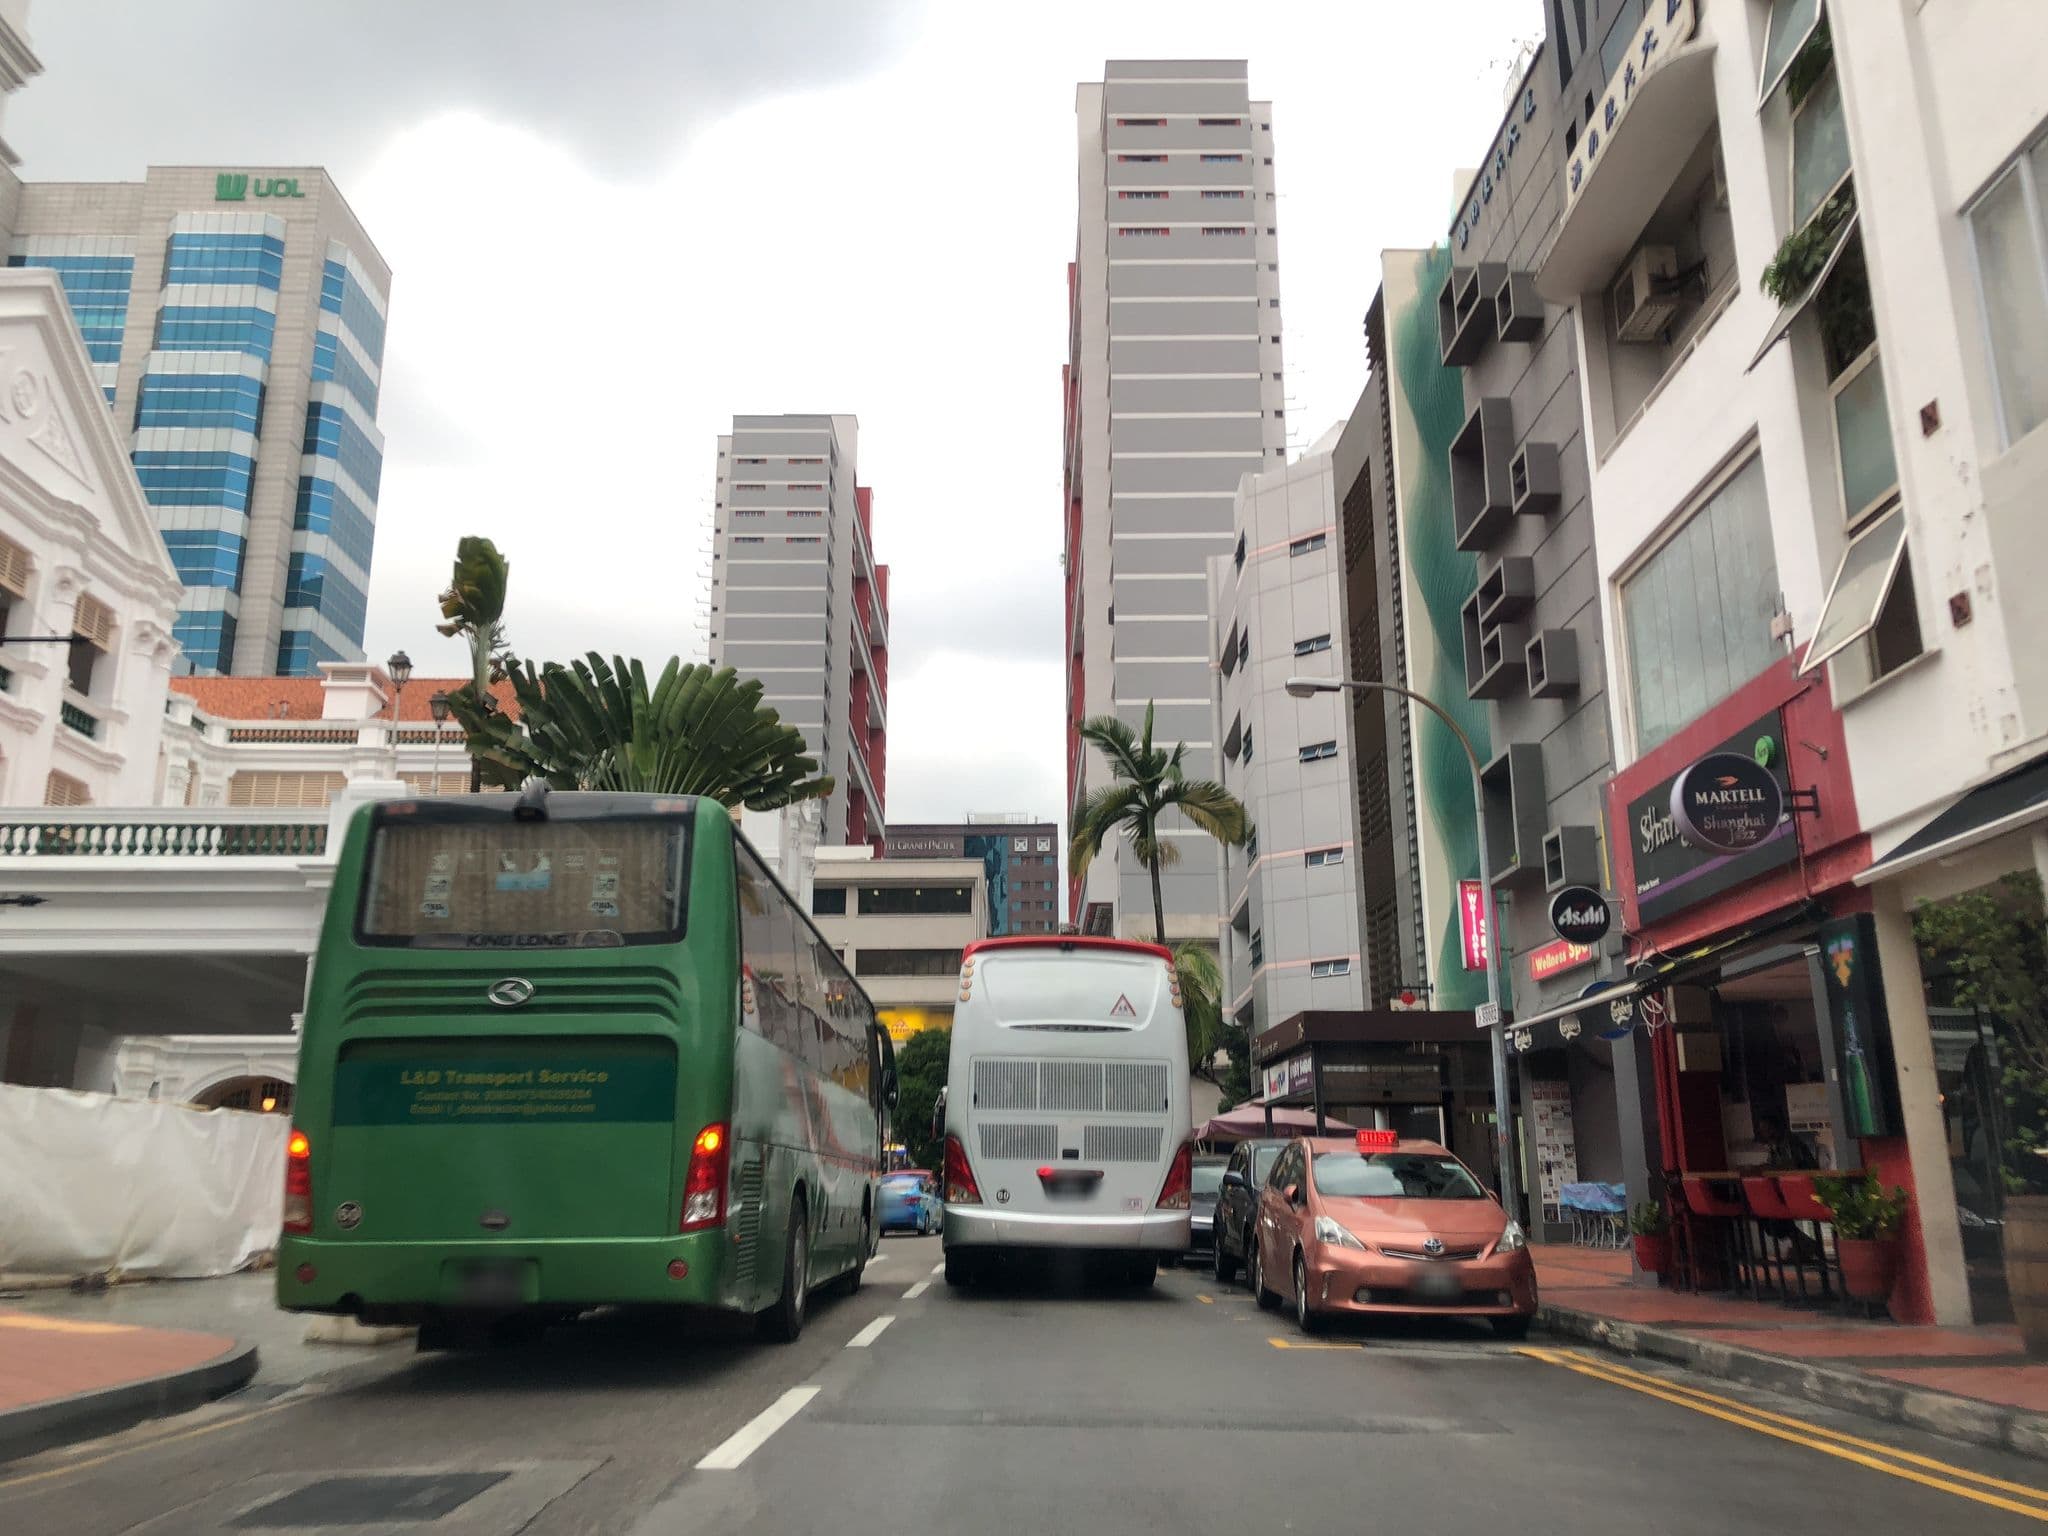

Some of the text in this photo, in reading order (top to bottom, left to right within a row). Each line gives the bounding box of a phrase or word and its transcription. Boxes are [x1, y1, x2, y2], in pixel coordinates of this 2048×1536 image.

[254, 178, 305, 198] UOL
[1695, 788, 1766, 805] MARTELL
[1558, 905, 1605, 926] Asahi
[1535, 949, 1567, 973] Wellness
[446, 1070, 533, 1086] Transport
[538, 1069, 609, 1084] Service
[1360, 1132, 1395, 1143] BUSY
